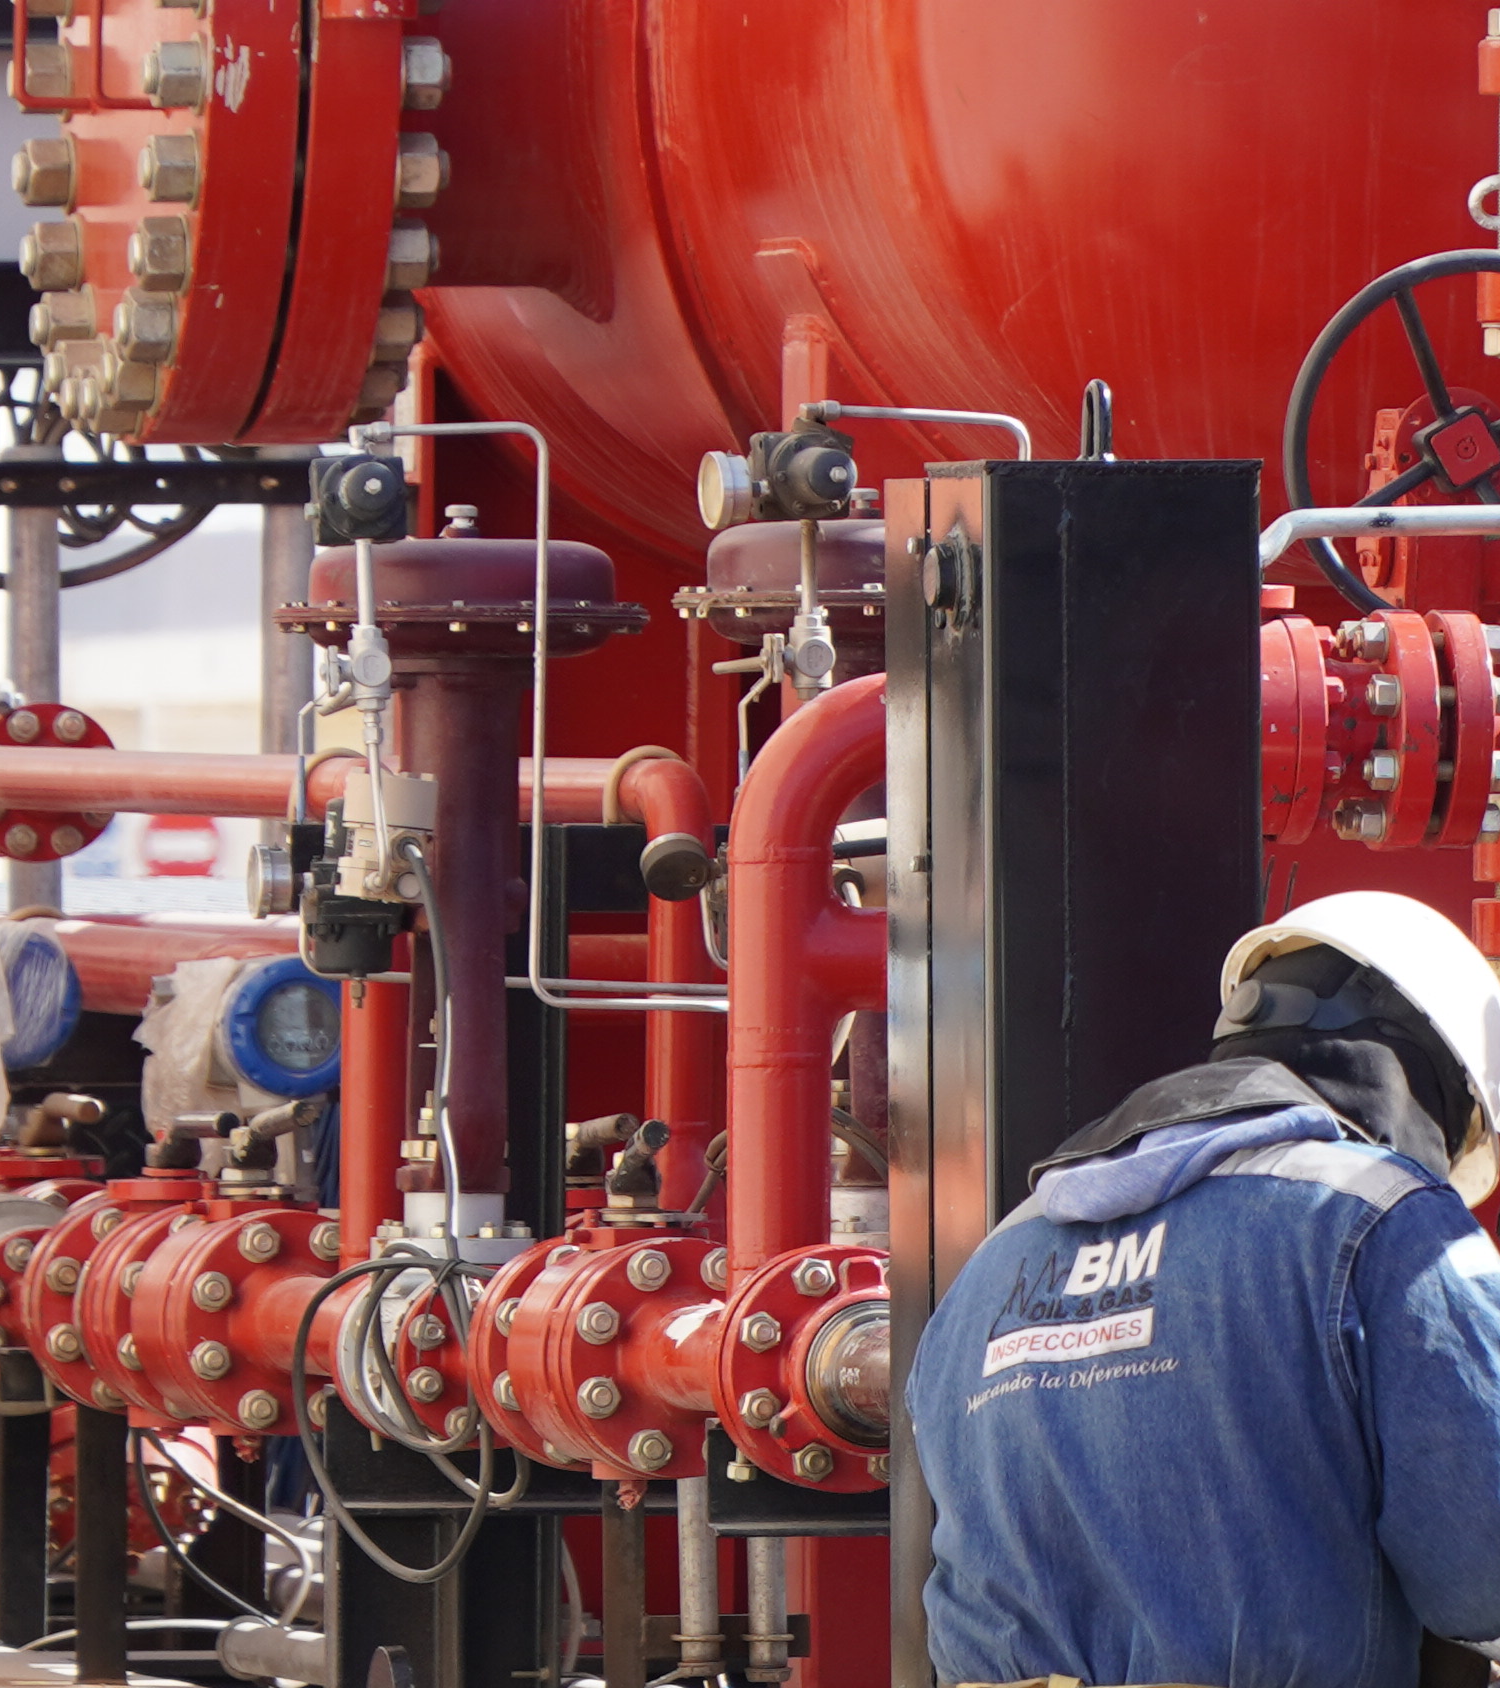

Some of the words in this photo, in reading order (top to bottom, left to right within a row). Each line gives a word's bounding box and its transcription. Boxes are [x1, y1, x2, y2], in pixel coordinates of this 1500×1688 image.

[1063, 1220, 1167, 1296] BM
[1027, 1299, 1068, 1322] OIL
[1075, 1298, 1095, 1317] &
[1100, 1281, 1155, 1311] GAS
[990, 1319, 1143, 1364] INSPECCIONES
[1039, 1371, 1065, 1389] la
[1068, 1356, 1180, 1390] Diferencia
